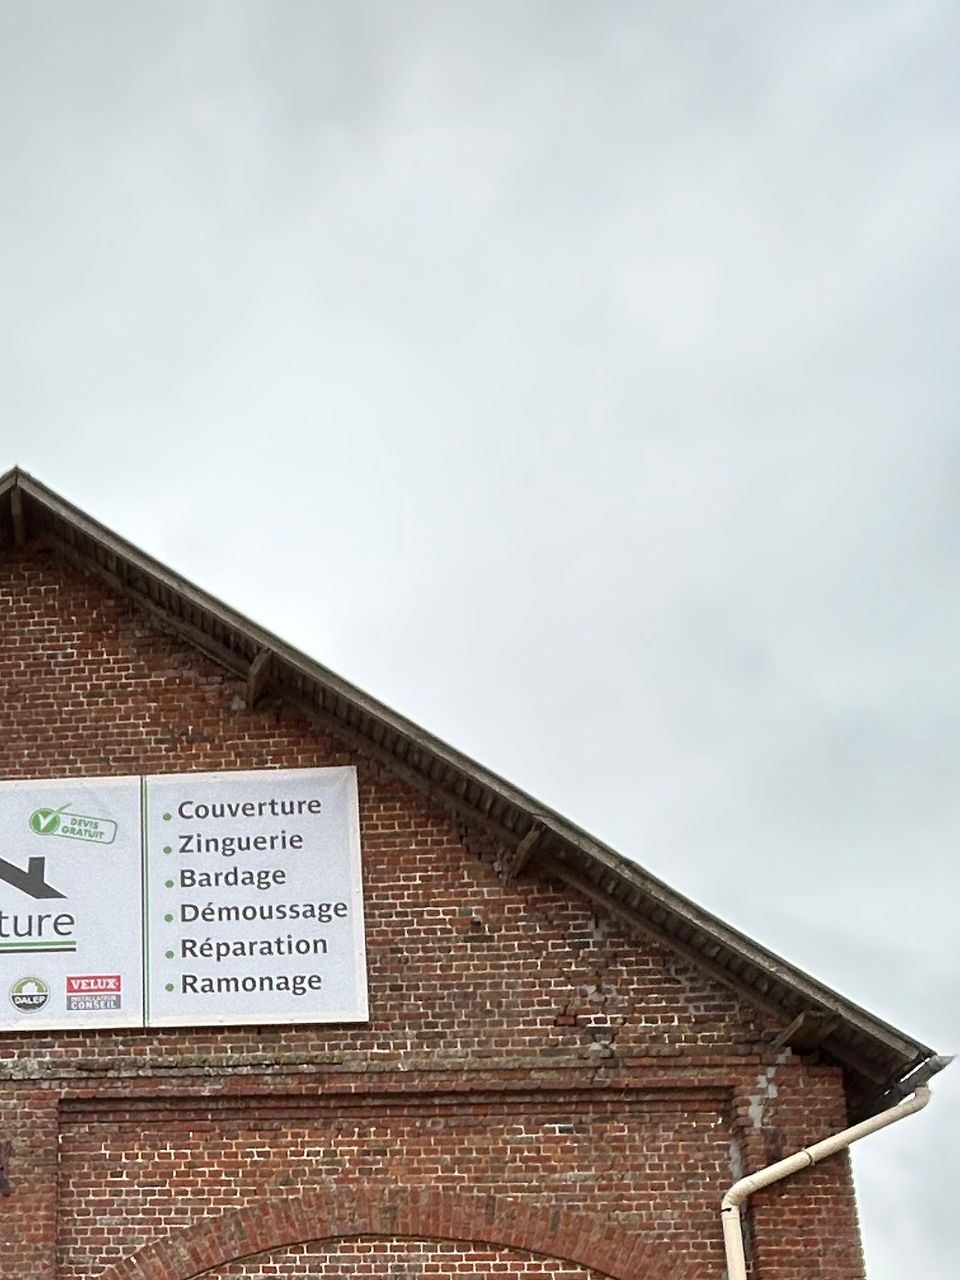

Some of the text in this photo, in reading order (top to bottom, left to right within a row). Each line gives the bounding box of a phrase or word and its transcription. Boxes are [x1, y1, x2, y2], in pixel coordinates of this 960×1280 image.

[178, 798, 322, 819] Couverture
[62, 825, 104, 839] GRATUIT
[70, 818, 99, 829] DEVIS
[178, 830, 303, 856] Zinguerie
[180, 866, 286, 889] Bardage
[180, 902, 348, 923] Démoussage
[181, 935, 328, 962] Réparation
[70, 979, 117, 990] VELUX
[182, 974, 322, 995] Ramonage
[14, 995, 46, 1004] DALEP
[70, 1000, 116, 1010] CONSEIL
